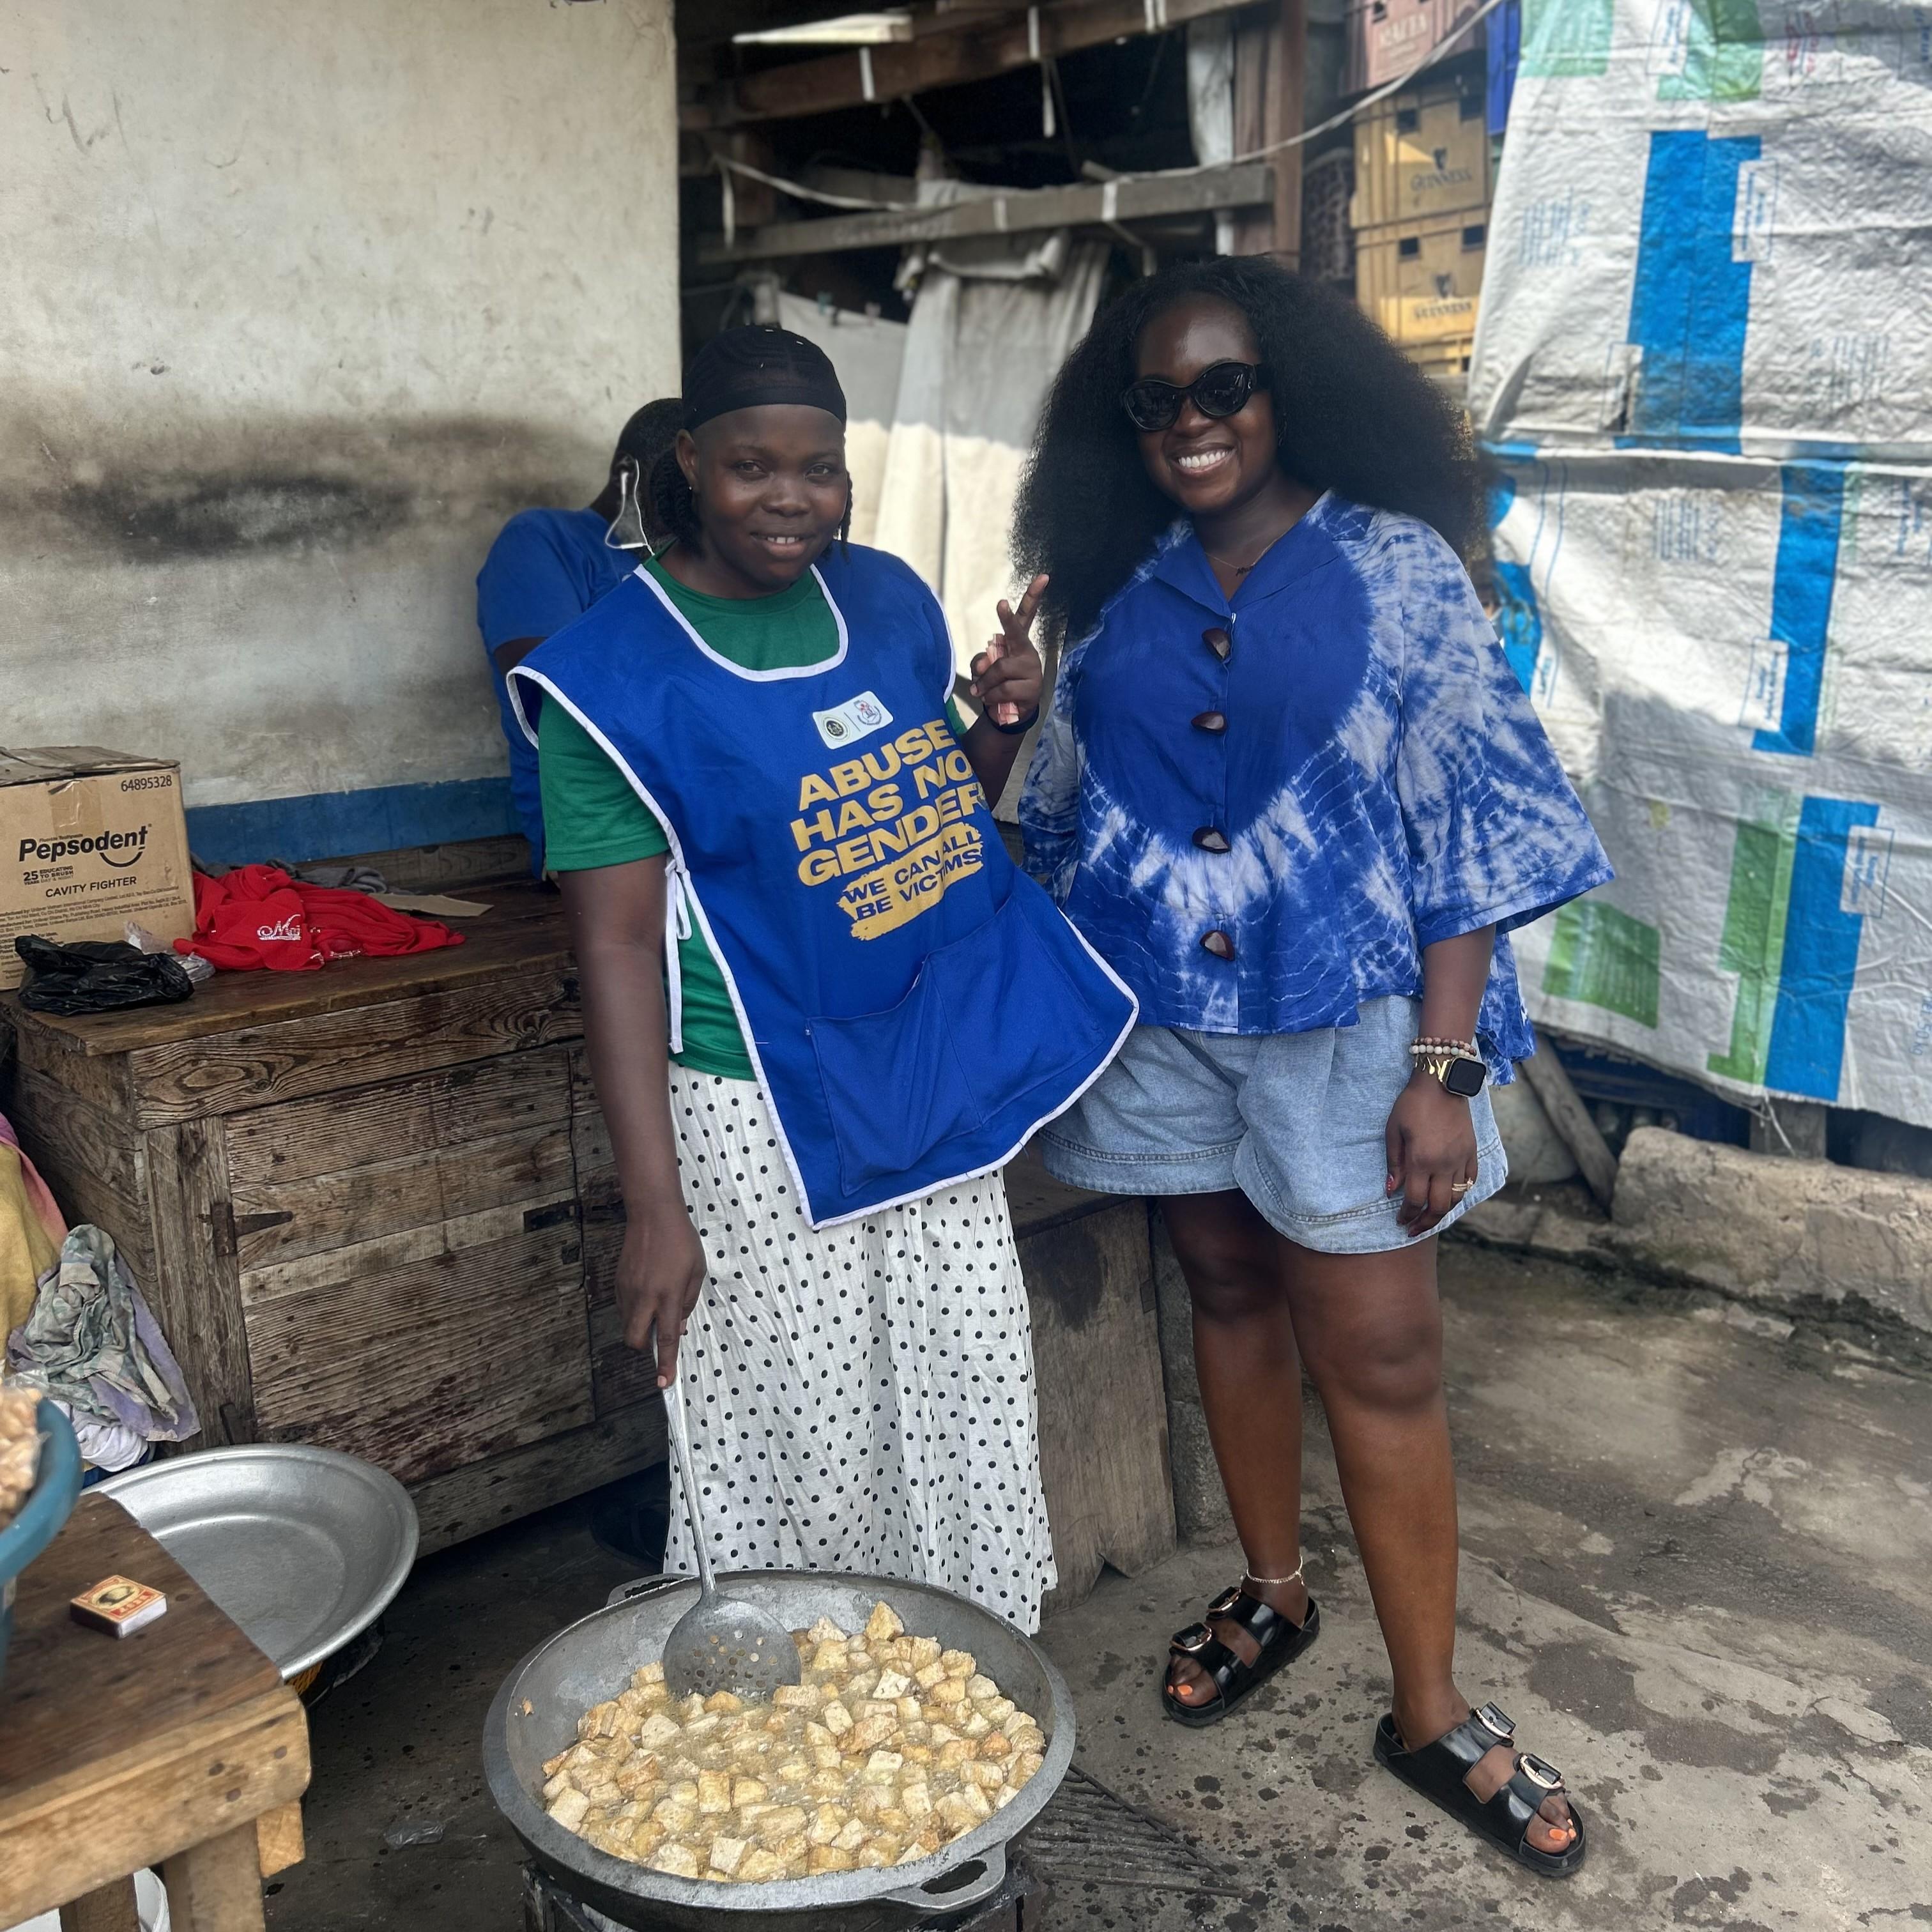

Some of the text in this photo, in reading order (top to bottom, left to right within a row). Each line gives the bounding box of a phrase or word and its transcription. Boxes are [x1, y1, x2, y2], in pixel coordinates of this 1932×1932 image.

[121, 774, 172, 792] 64895328
[790, 749, 974, 853] HAS NO
[799, 719, 956, 812] ABUSE
[19, 825, 148, 862] Pepsodent
[798, 781, 988, 887] GENDER
[842, 831, 981, 904] WE CAN ALL
[23, 865, 73, 882] 25 EDUCATING
[45, 876, 137, 898] CAVITY FIGHTER
[855, 848, 983, 920] BE VICTIMS
